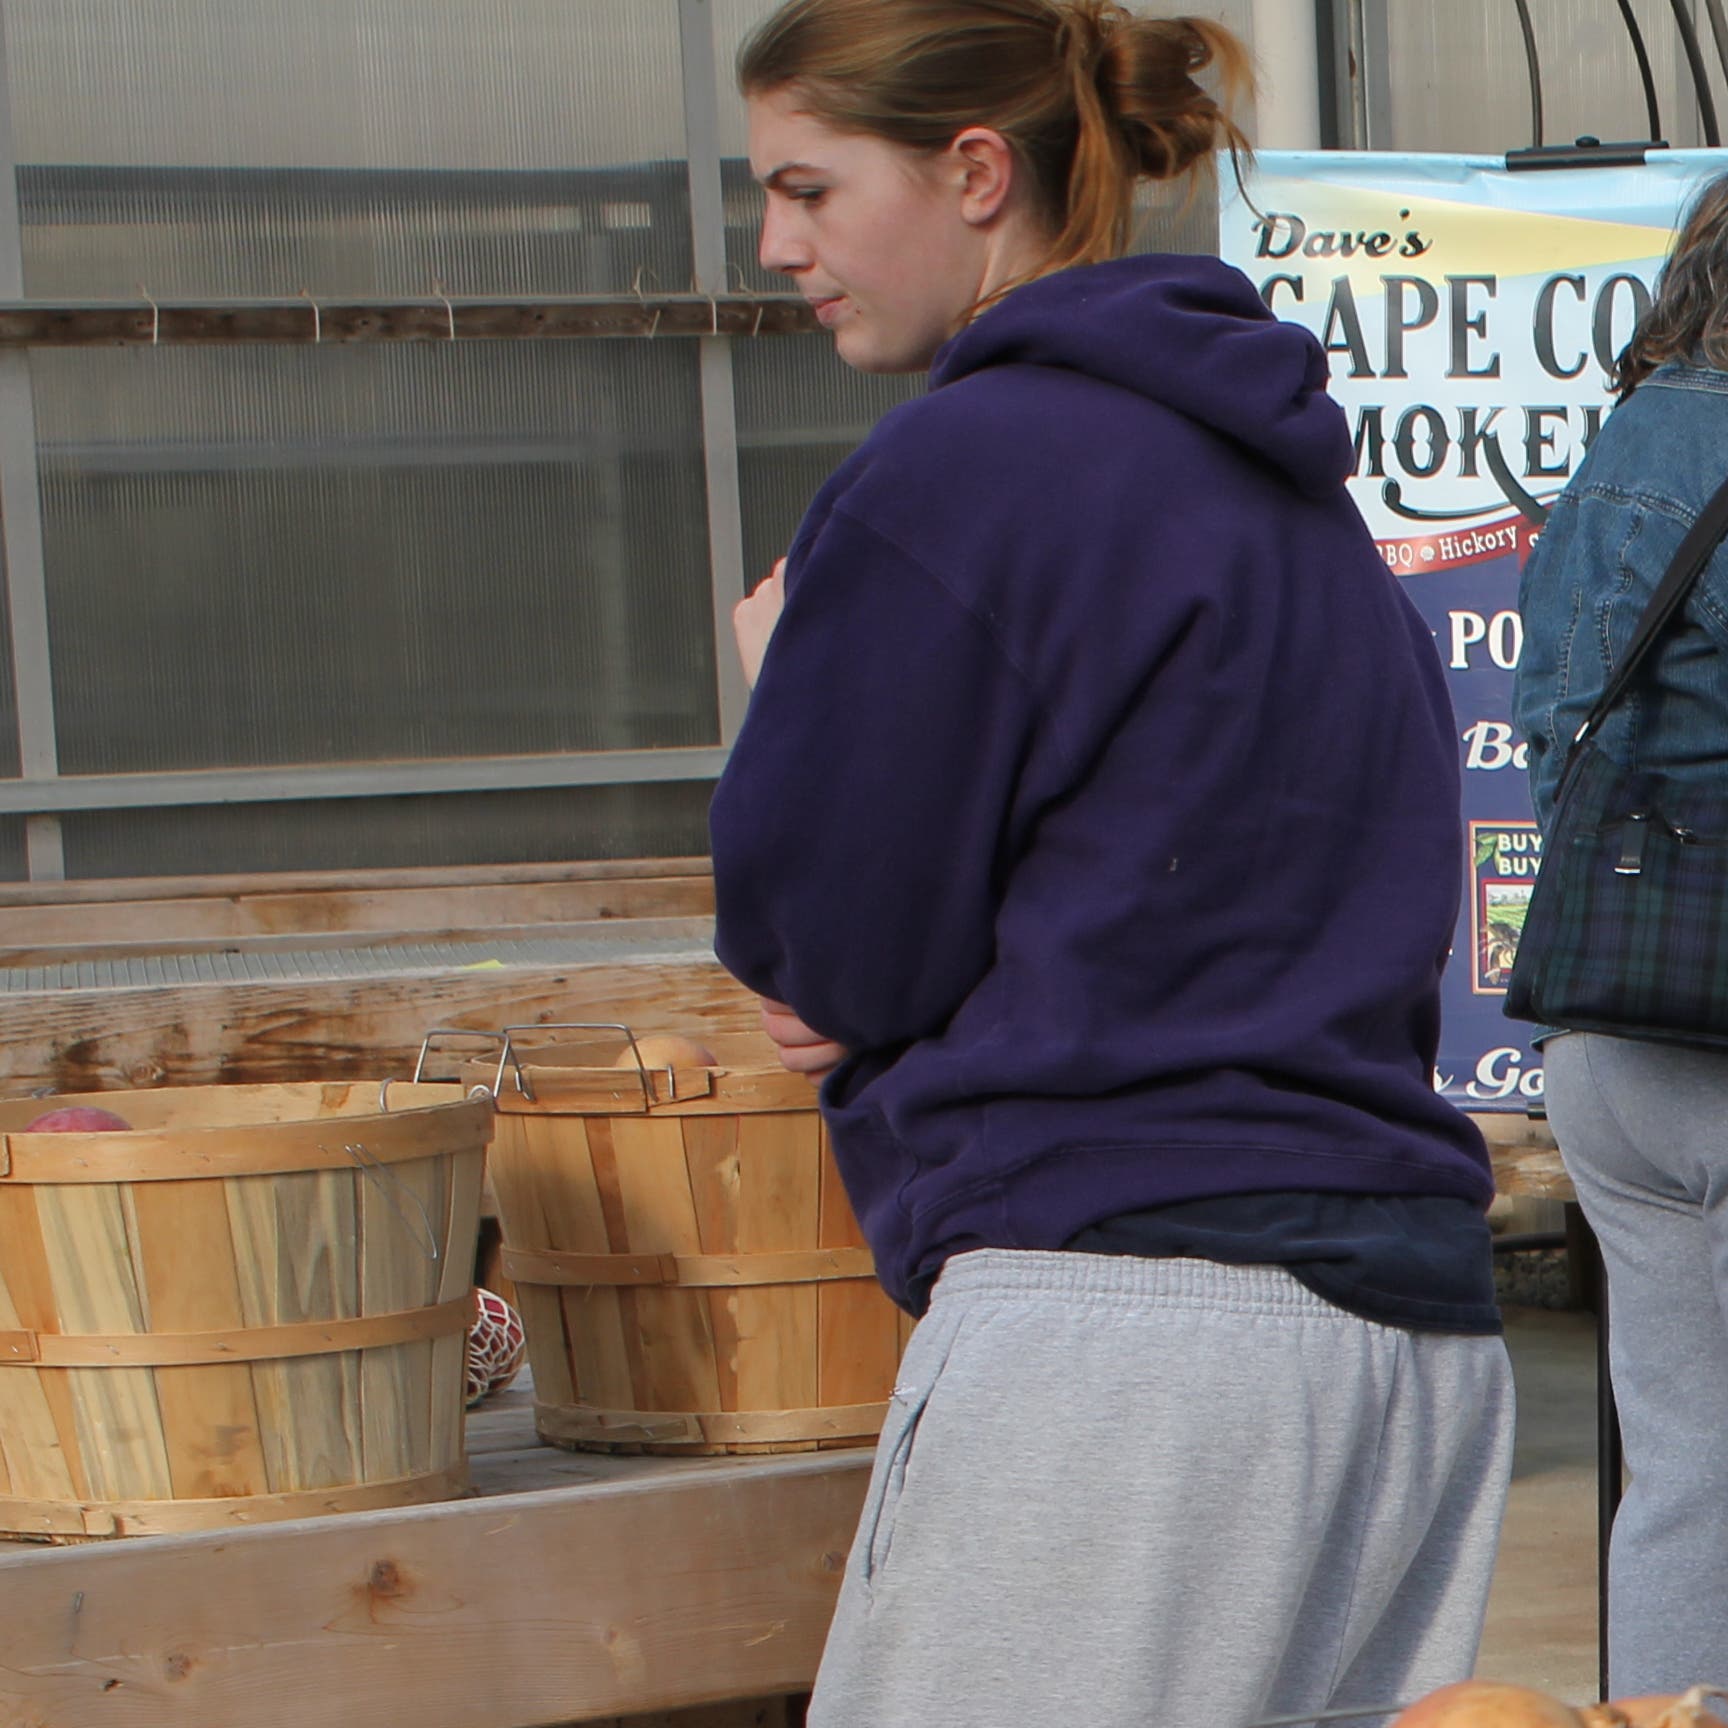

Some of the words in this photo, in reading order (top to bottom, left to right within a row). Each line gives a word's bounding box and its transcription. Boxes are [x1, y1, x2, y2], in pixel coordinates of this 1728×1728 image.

[1251, 208, 1432, 259] Dave's
[1532, 274, 1653, 379] CO
[1377, 543, 1414, 568] BQ
[1439, 525, 1518, 560] Hickory
[1497, 834, 1543, 853] BUY
